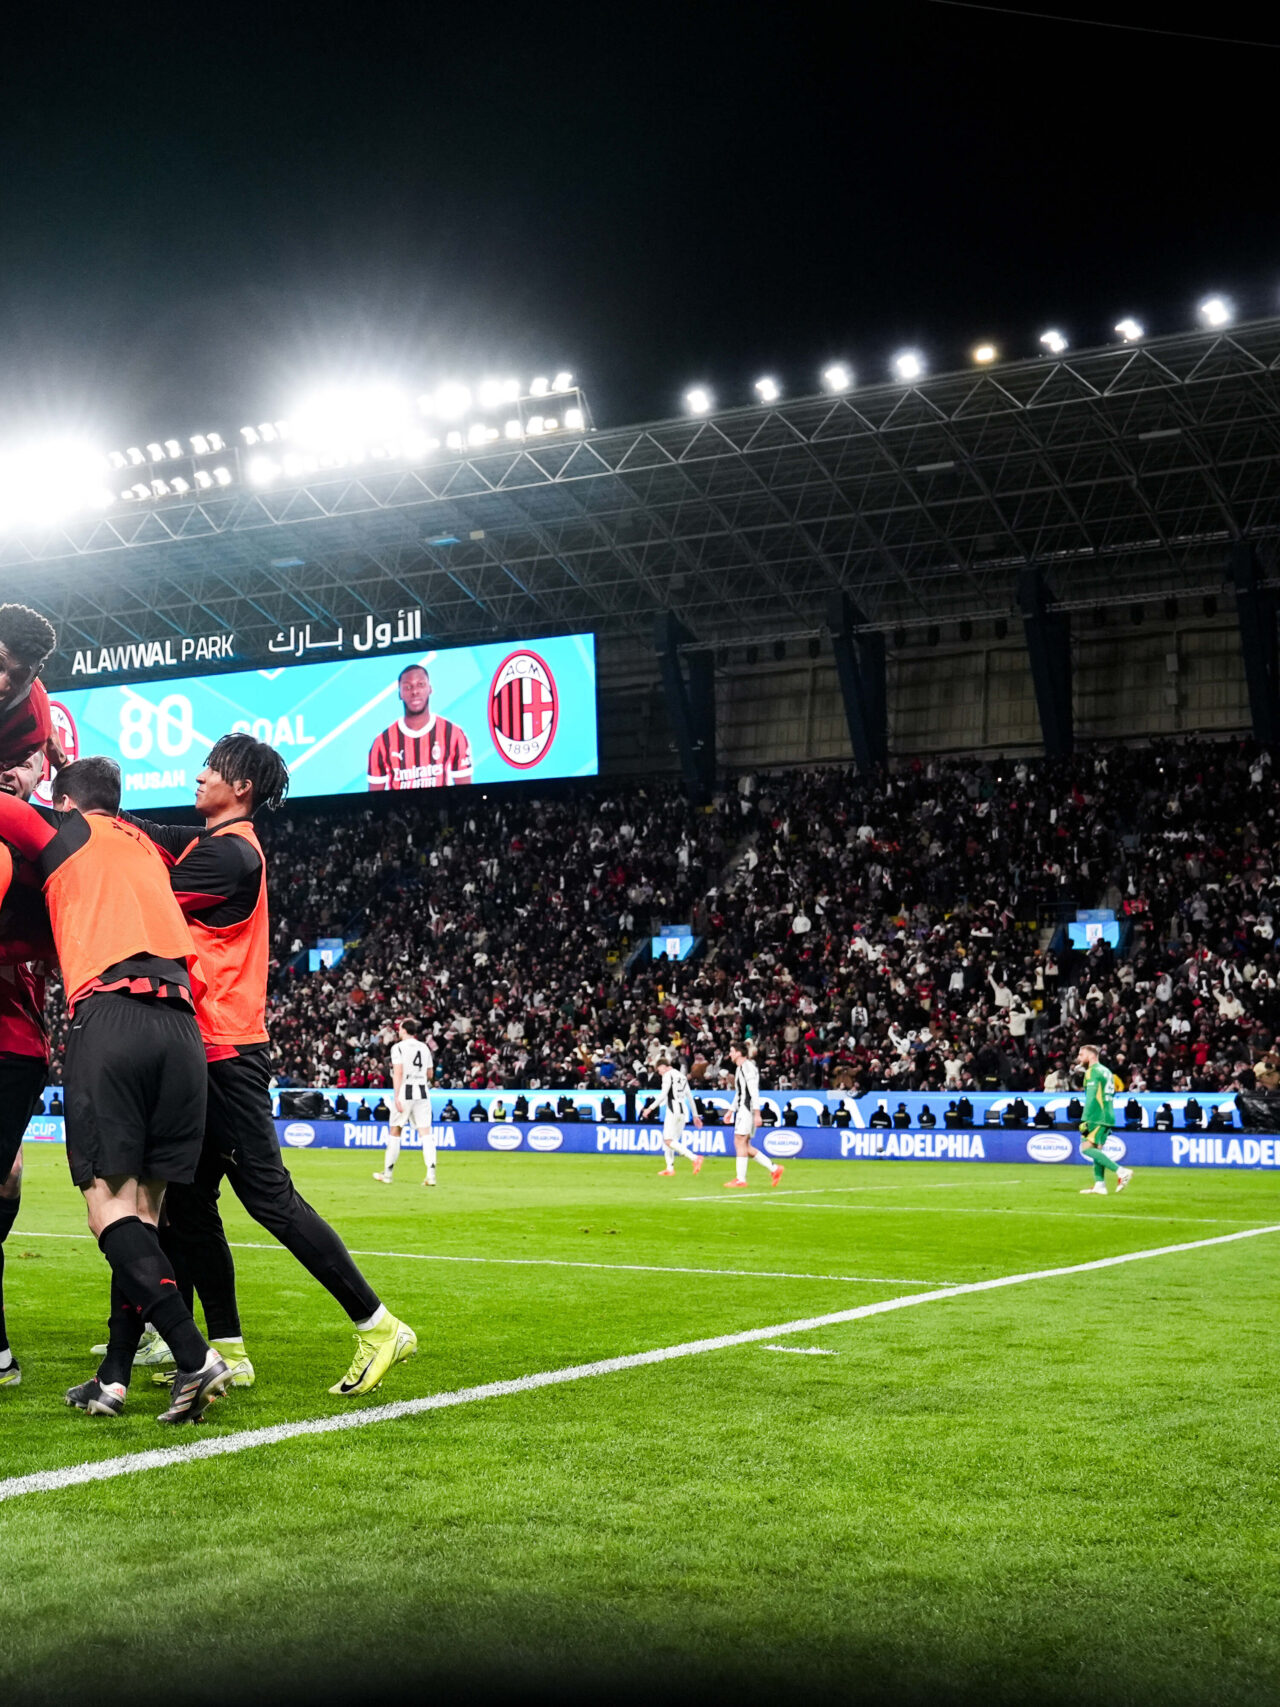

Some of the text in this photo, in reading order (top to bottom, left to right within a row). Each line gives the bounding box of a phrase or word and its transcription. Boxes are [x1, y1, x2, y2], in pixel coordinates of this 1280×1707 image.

[353, 609, 421, 651] الأول
[71, 634, 234, 675] ALAWWAL PARK
[504, 659, 541, 681] ACM
[119, 694, 193, 760] 80
[507, 740, 540, 755] 1899
[125, 769, 186, 791] MUSAH
[412, 1050, 423, 1072] 4
[840, 1130, 985, 1158] PHILADELPHIA
